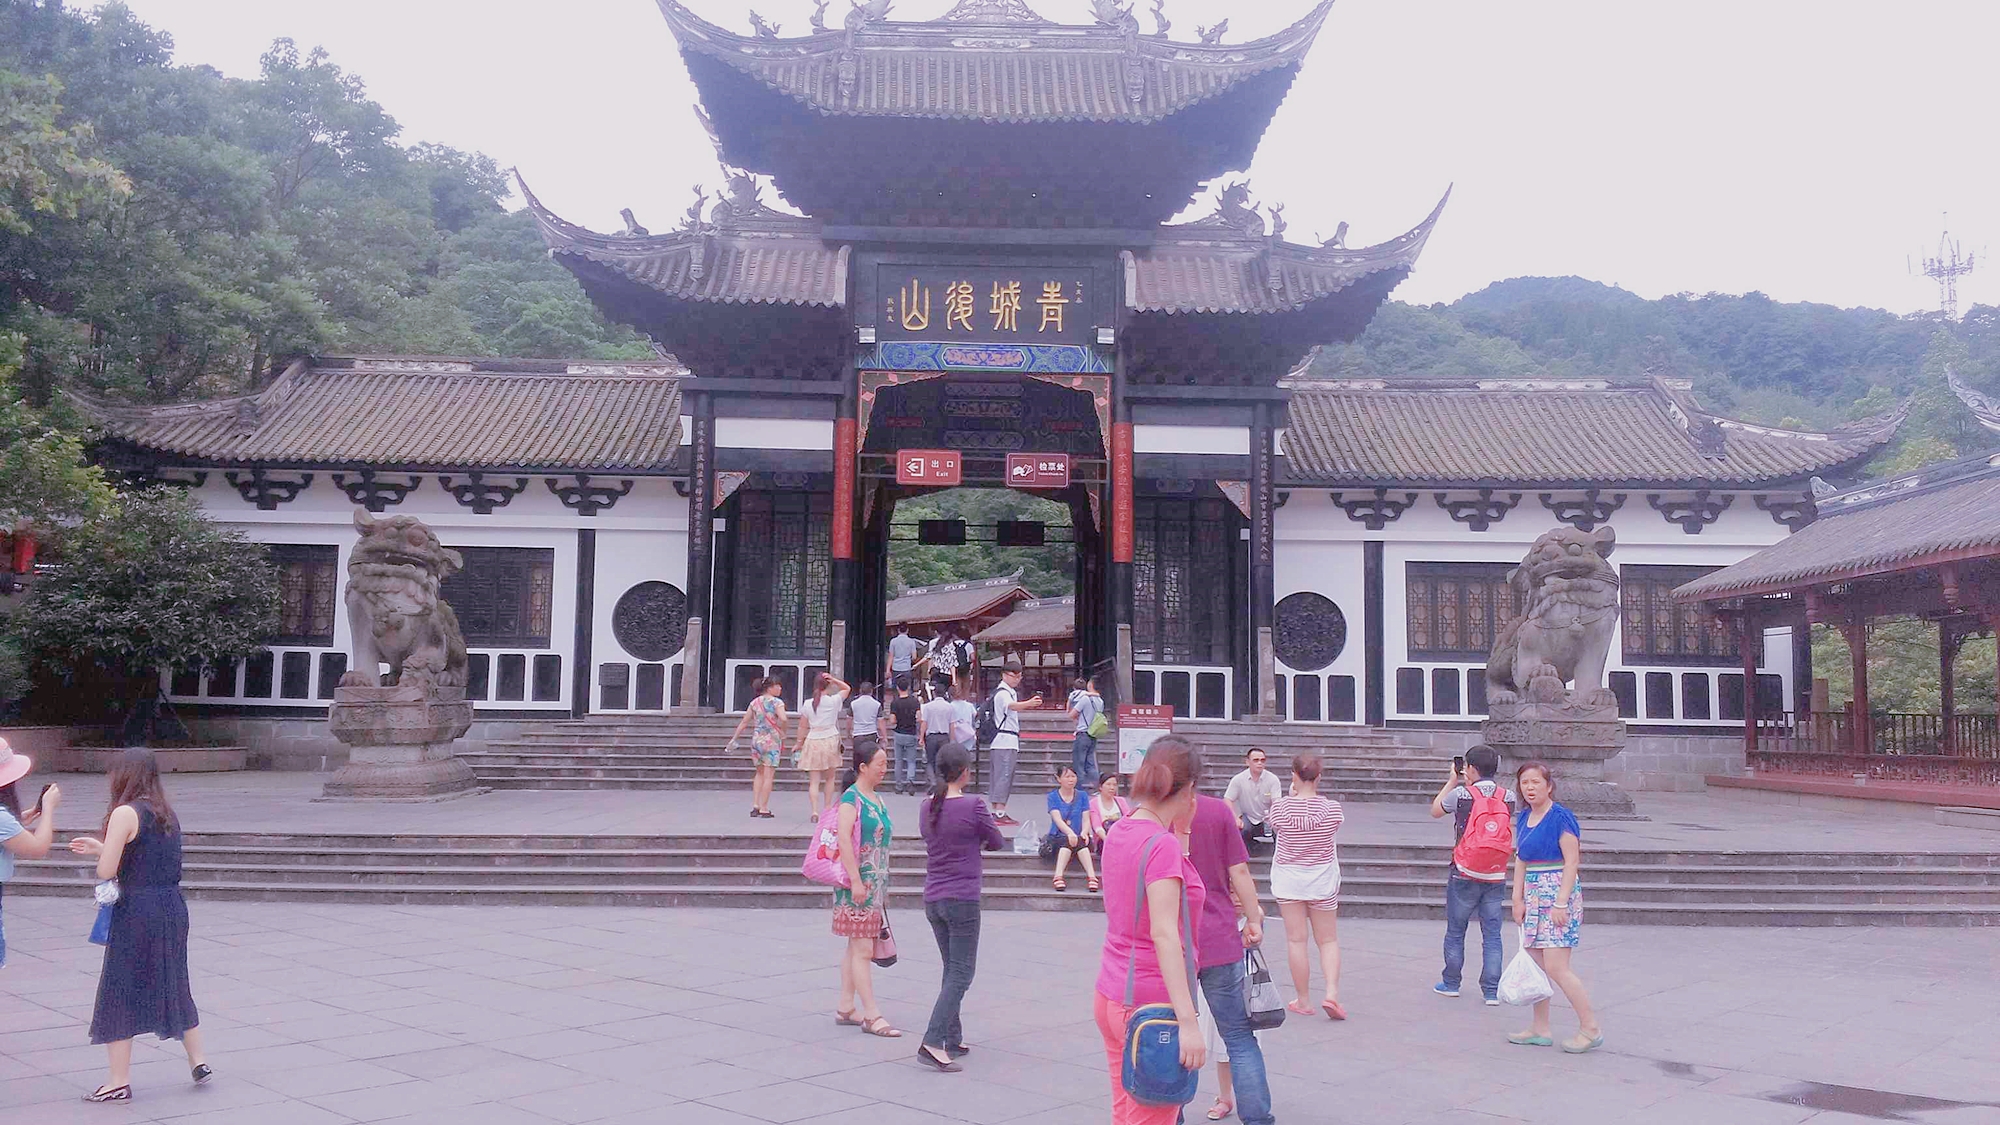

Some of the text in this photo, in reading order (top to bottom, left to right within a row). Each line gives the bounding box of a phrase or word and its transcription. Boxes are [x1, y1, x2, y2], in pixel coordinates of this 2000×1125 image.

[931, 459, 954, 468] 出口
[1039, 462, 1065, 471] 检票处
